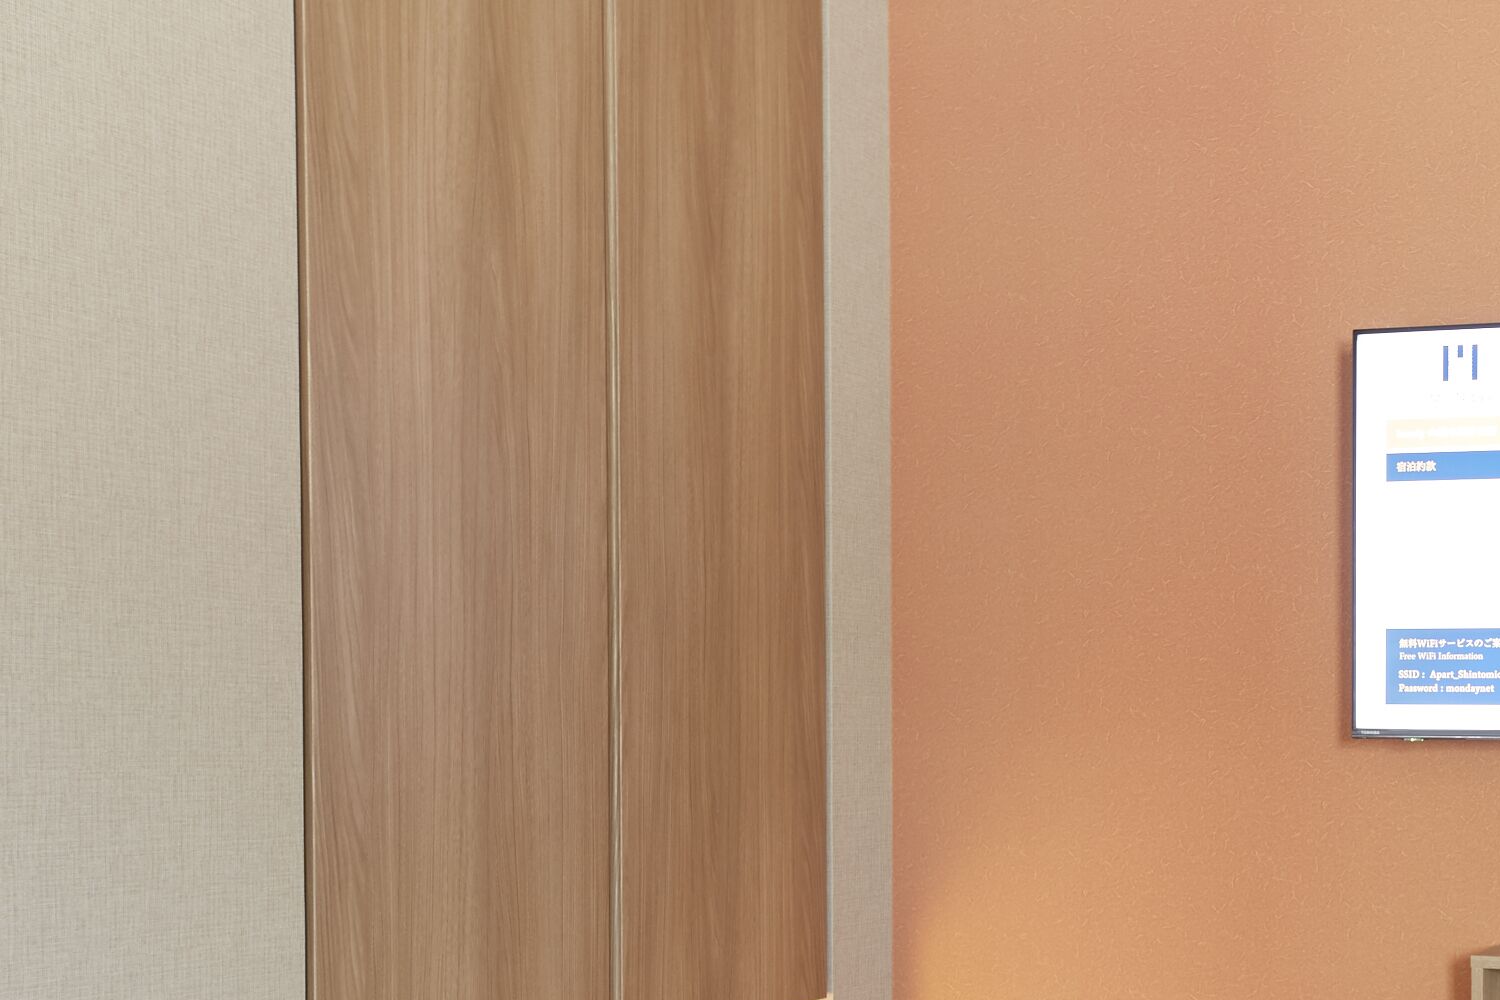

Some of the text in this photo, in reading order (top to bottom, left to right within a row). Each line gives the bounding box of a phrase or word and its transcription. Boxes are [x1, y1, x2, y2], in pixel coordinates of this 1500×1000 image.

[1399, 652, 1416, 660] Free
[1438, 652, 1483, 660] Information
[1446, 684, 1495, 695] mondaynet
